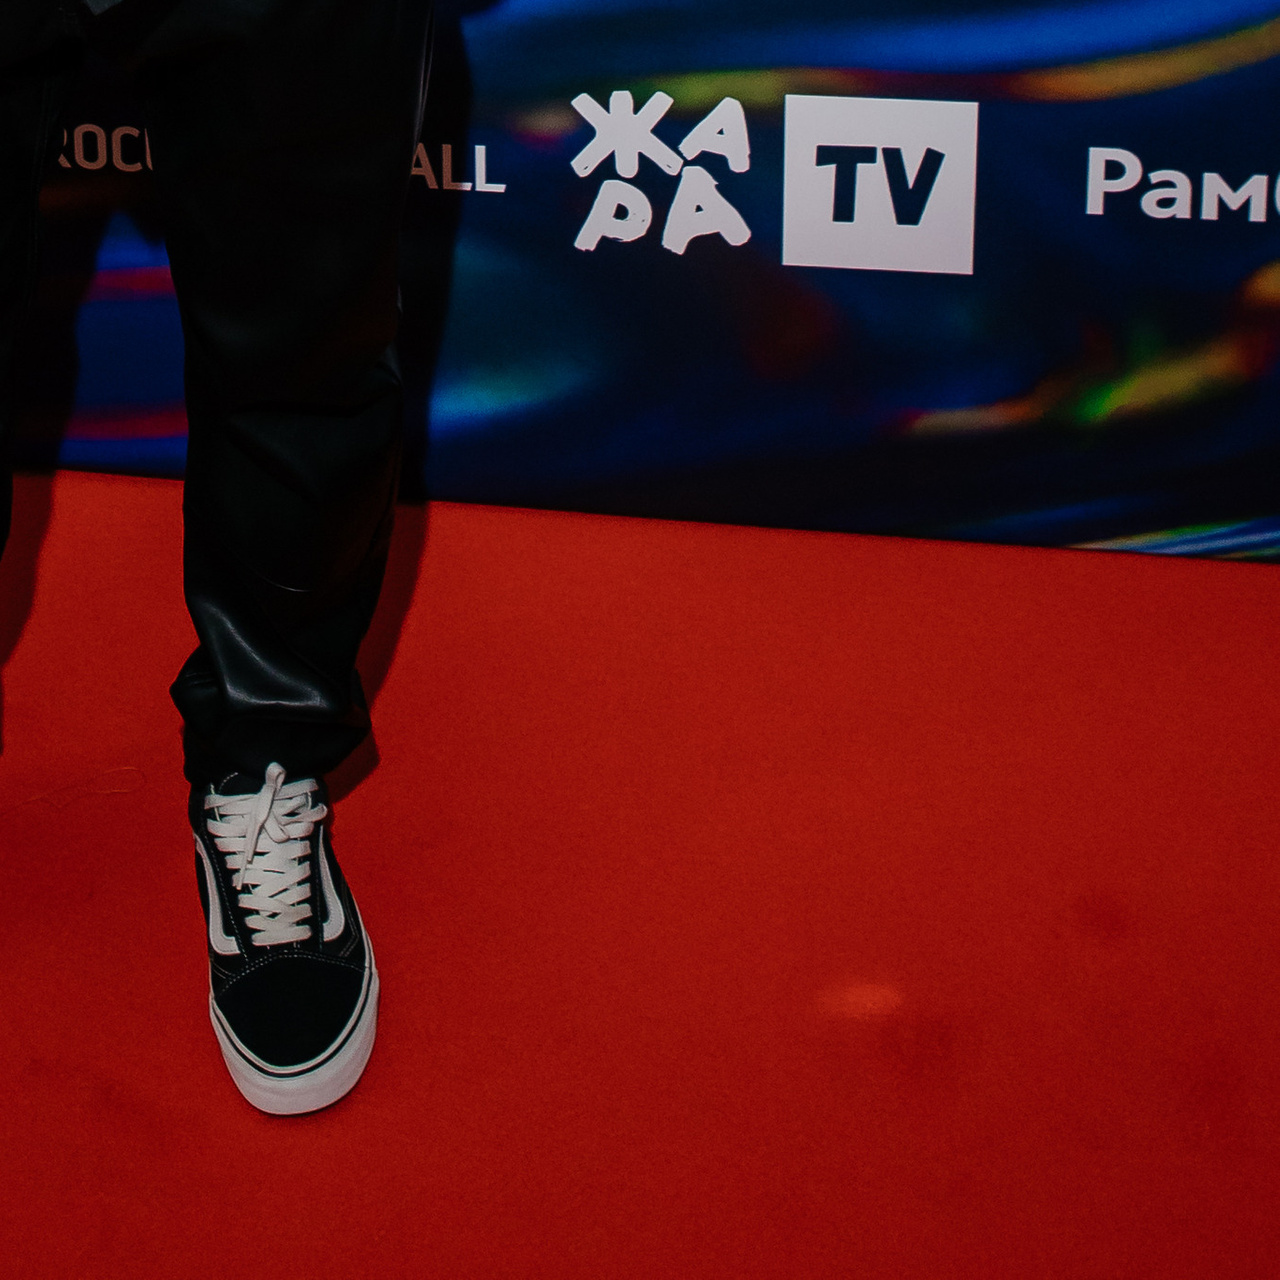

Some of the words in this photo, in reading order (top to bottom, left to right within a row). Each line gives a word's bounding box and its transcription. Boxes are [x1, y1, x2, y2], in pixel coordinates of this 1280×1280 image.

[57, 123, 154, 172] OC
[815, 144, 946, 227] TV
[1085, 146, 1280, 223] Рам
